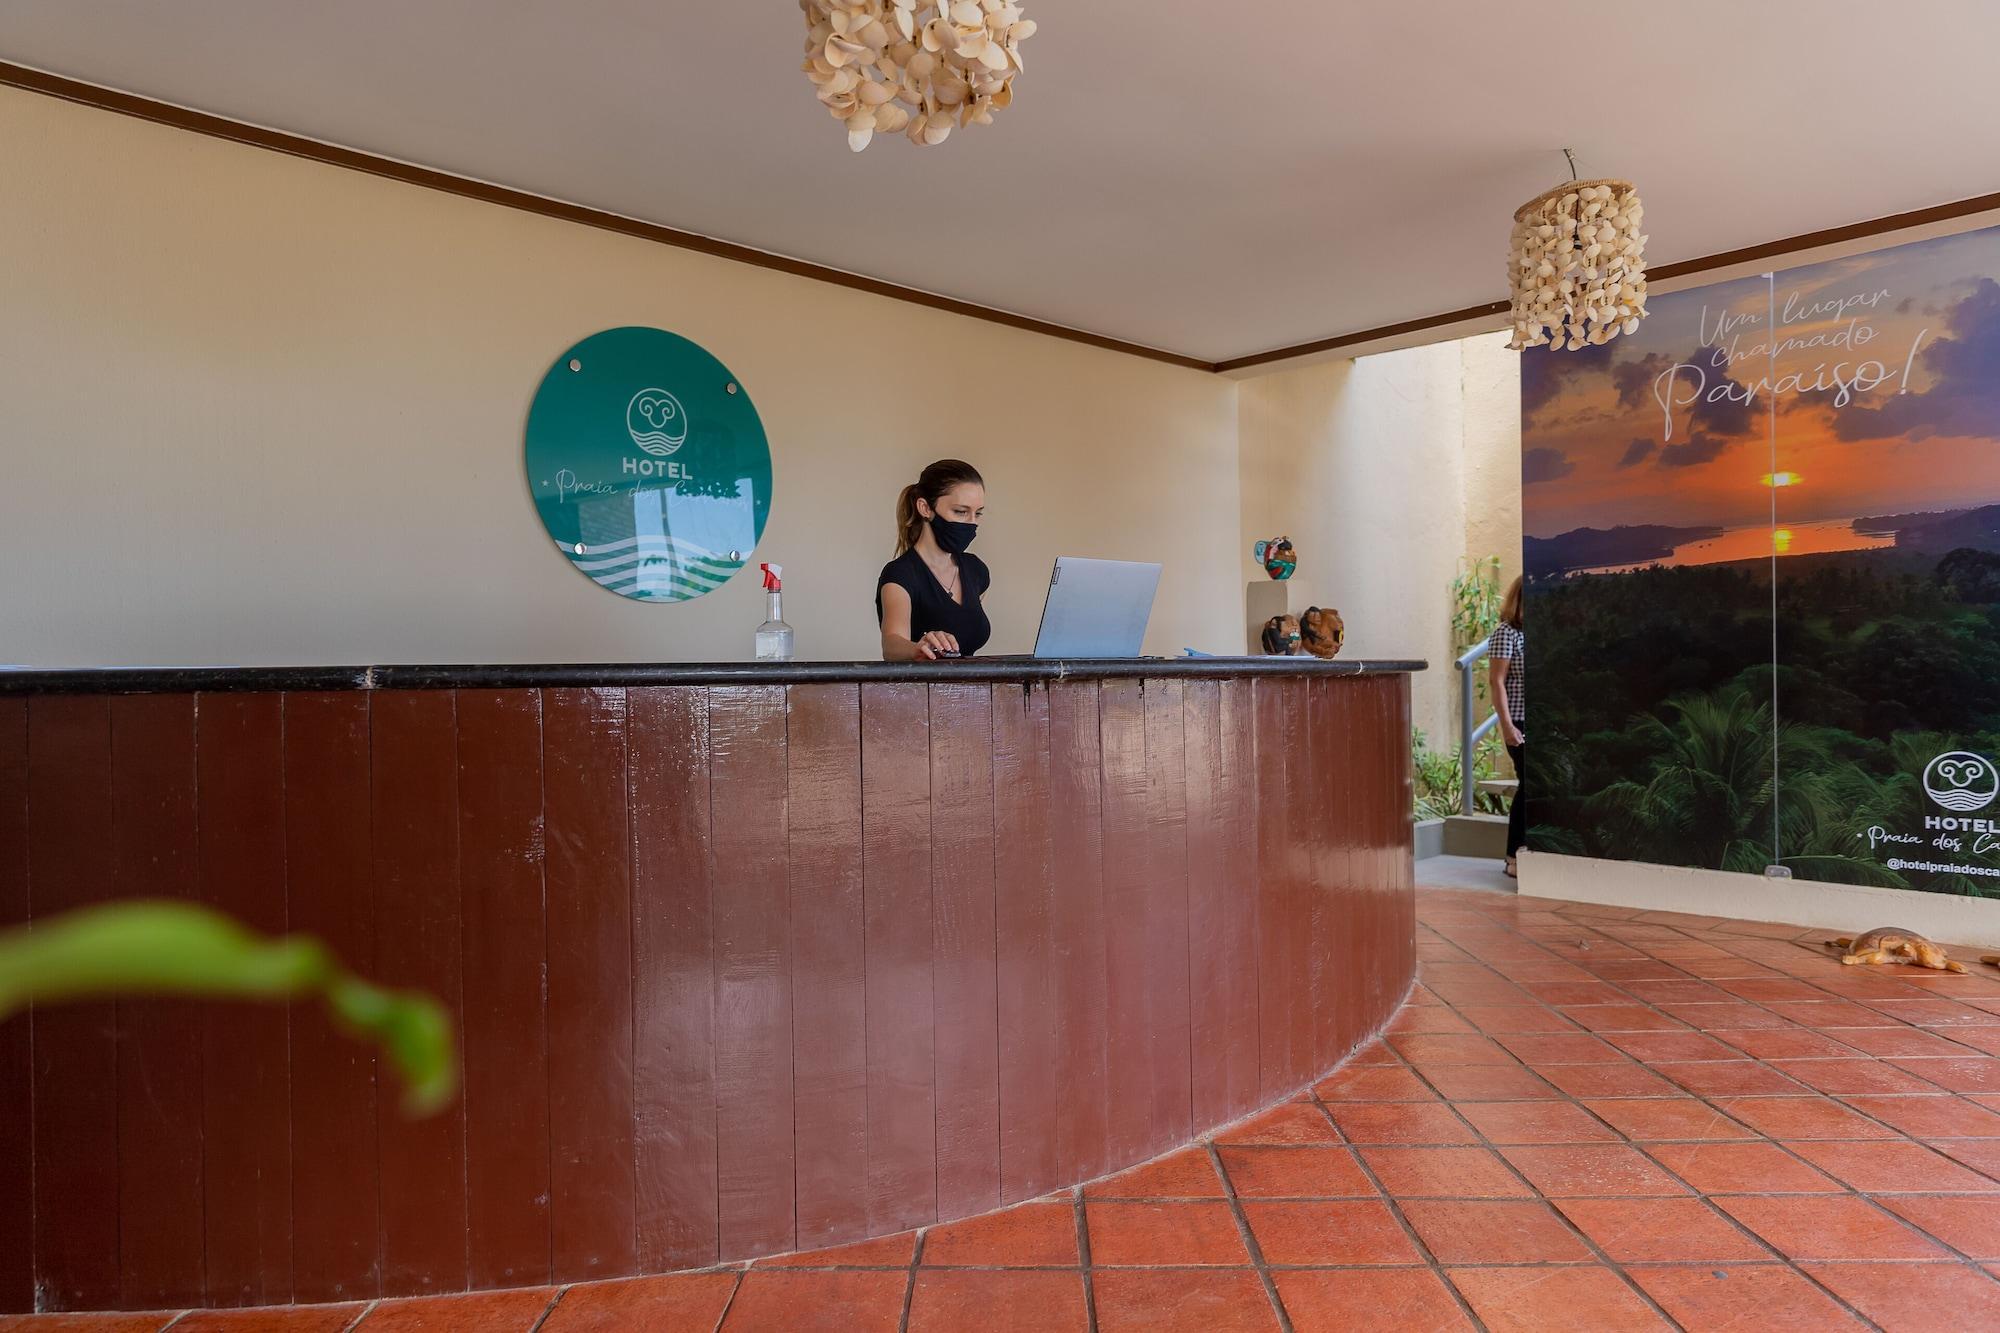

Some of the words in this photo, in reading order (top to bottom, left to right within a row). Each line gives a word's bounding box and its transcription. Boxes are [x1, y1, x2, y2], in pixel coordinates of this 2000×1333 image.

[1699, 304, 1763, 348] Um
[1782, 287, 1893, 324] lugar
[1710, 318, 1880, 369] chamado
[1653, 328, 1929, 442] Paraíso!
[556, 468, 618, 504] Praia
[622, 457, 693, 480] HOTEL
[1867, 825, 1924, 850] Praia
[1932, 833, 1963, 852] dos
[1925, 816, 2000, 834] HOTEL
